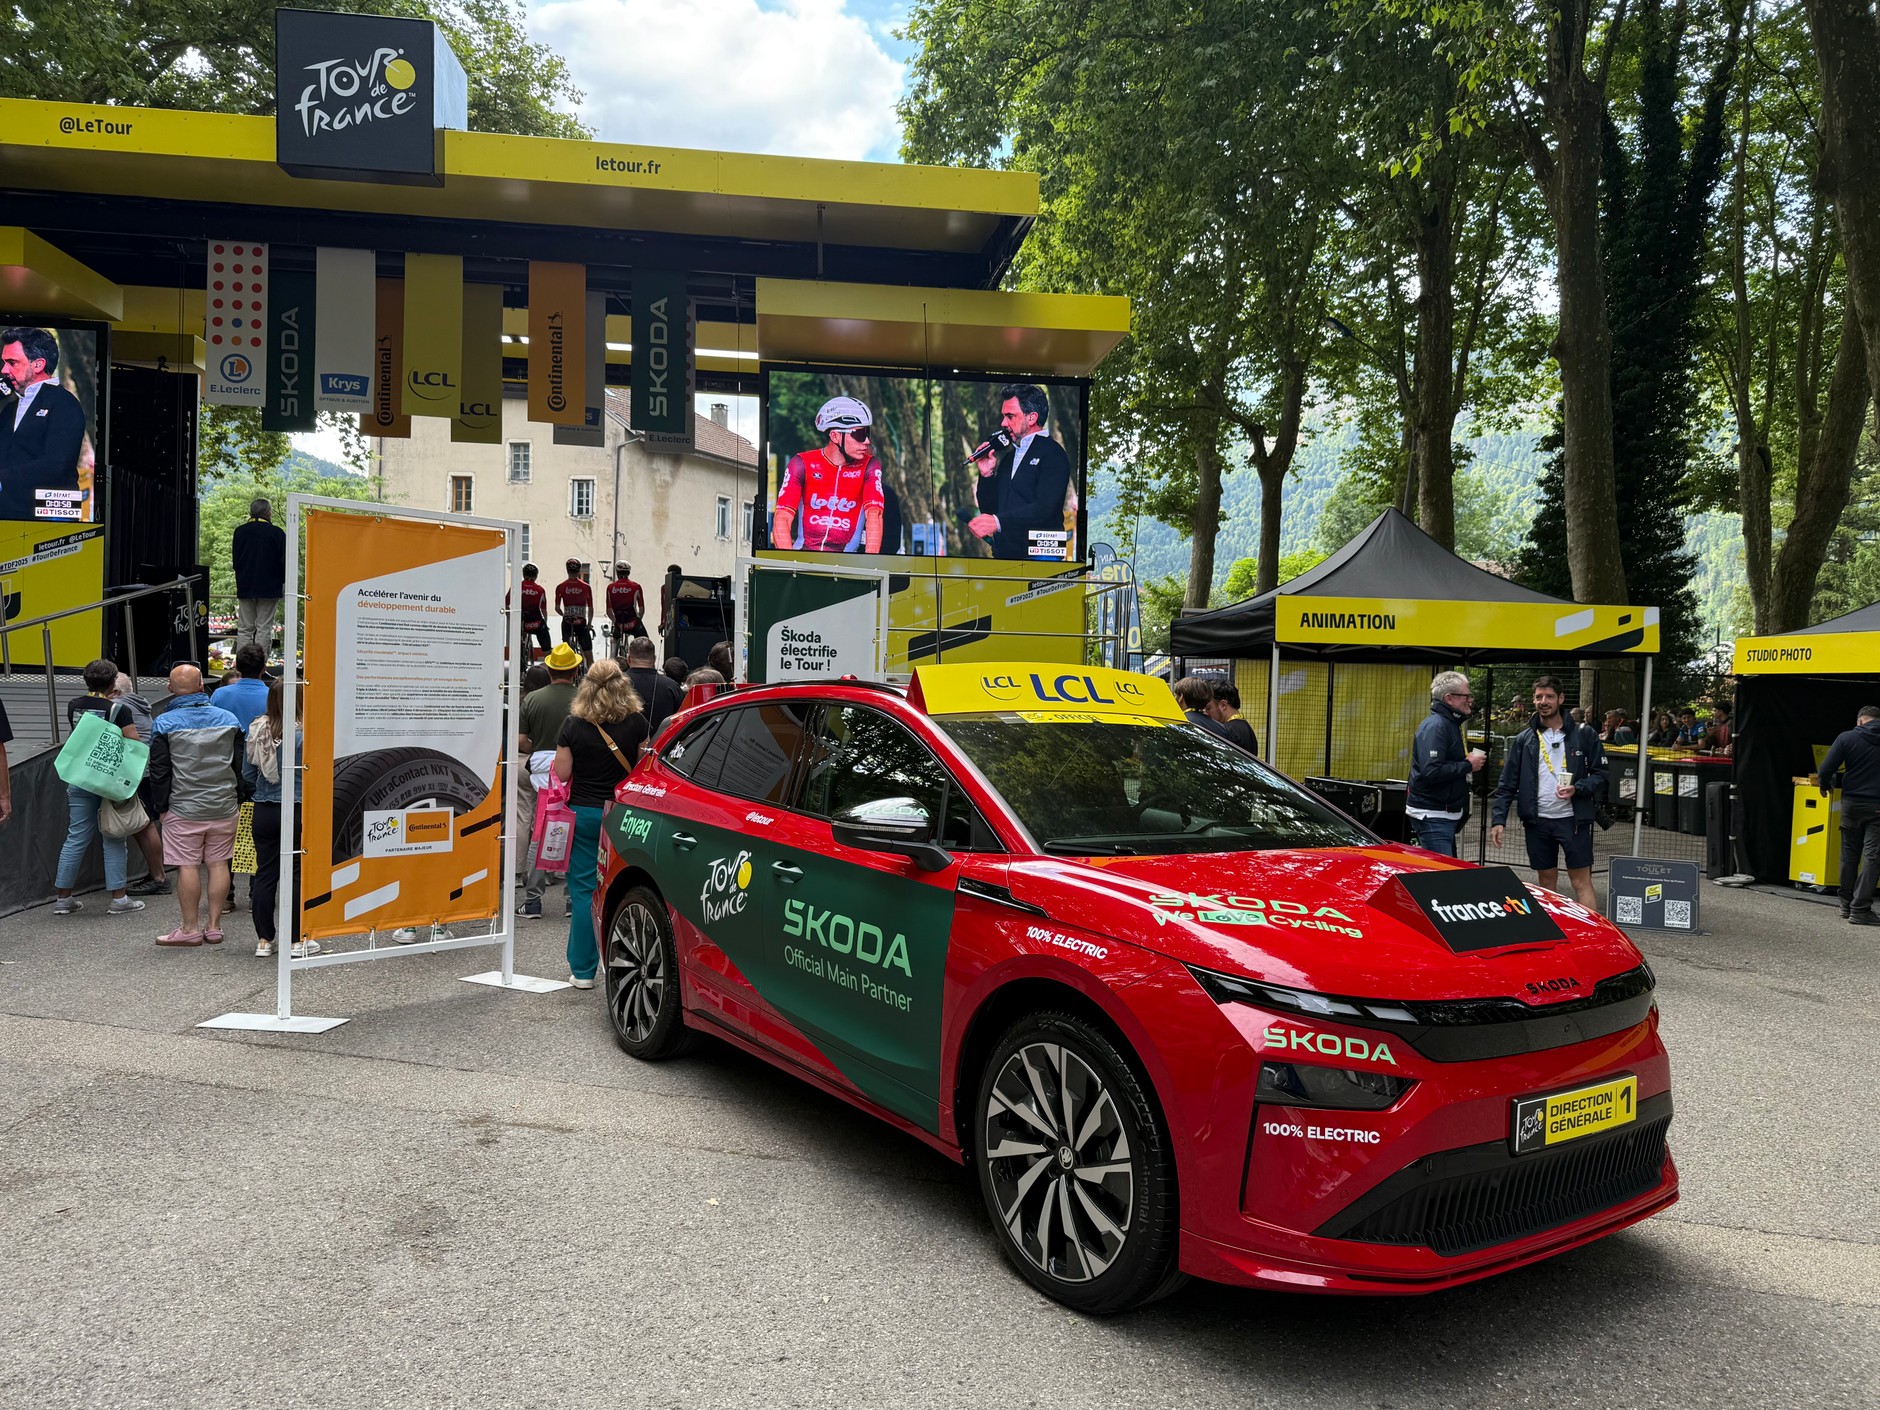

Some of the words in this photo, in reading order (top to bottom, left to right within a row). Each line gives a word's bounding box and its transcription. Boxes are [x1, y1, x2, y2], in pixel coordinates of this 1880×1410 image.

[371, 80, 388, 97] de
[59, 117, 133, 135] @LeTour
[596, 156, 661, 175] letour.fr
[547, 325, 566, 412] Continental
[329, 377, 361, 391] Krys
[377, 348, 394, 427] Continental
[413, 371, 455, 387] LCL
[210, 384, 261, 396] E.Leclerc
[460, 402, 497, 416] LCL
[649, 434, 691, 444] E.Leclerc
[810, 493, 856, 512] lotto
[39, 537, 65, 550] letour.fr
[69, 530, 96, 544] @LeTour
[1, 558, 28, 570] #TDF2025
[32, 545, 78, 562] #TourDeFrance
[358, 588, 398, 599] Accélérer
[430, 594, 441, 602] du
[358, 600, 423, 612] développement
[425, 604, 456, 614] durable
[1300, 612, 1395, 629] ANIMATION
[781, 625, 821, 643] Škoda
[781, 643, 837, 657] électrifie
[1747, 649, 1778, 662] STUDIO
[1780, 647, 1812, 661] PHOTO
[781, 657, 792, 669] le
[795, 657, 824, 670] Tour
[983, 676, 1021, 688] LCL
[1029, 673, 1115, 704] LCL
[1115, 681, 1144, 696] LCL
[369, 765, 428, 806] UltraContact
[431, 763, 449, 776] NXT
[401, 789, 412, 800] R18
[413, 783, 426, 794] 99V
[409, 822, 442, 832] Continental
[620, 809, 652, 843] Enyaq
[746, 811, 775, 826] @letour
[1637, 865, 1671, 874] TOULET
[729, 879, 737, 894] de
[1152, 909, 1195, 927] We
[1269, 915, 1363, 938] Cycling
[1026, 925, 1054, 943] 100%
[1052, 933, 1108, 959] ELECTRIC
[784, 945, 825, 977] Official
[827, 961, 858, 991] Main
[861, 973, 912, 1012] Partner
[1550, 1091, 1612, 1117] DIRECTION
[1620, 1085, 1631, 1113] 1
[1550, 1107, 1612, 1134] GÉNÉRALE
[1263, 1122, 1303, 1138] 100%
[1307, 1125, 1380, 1144] ELECTRIC
